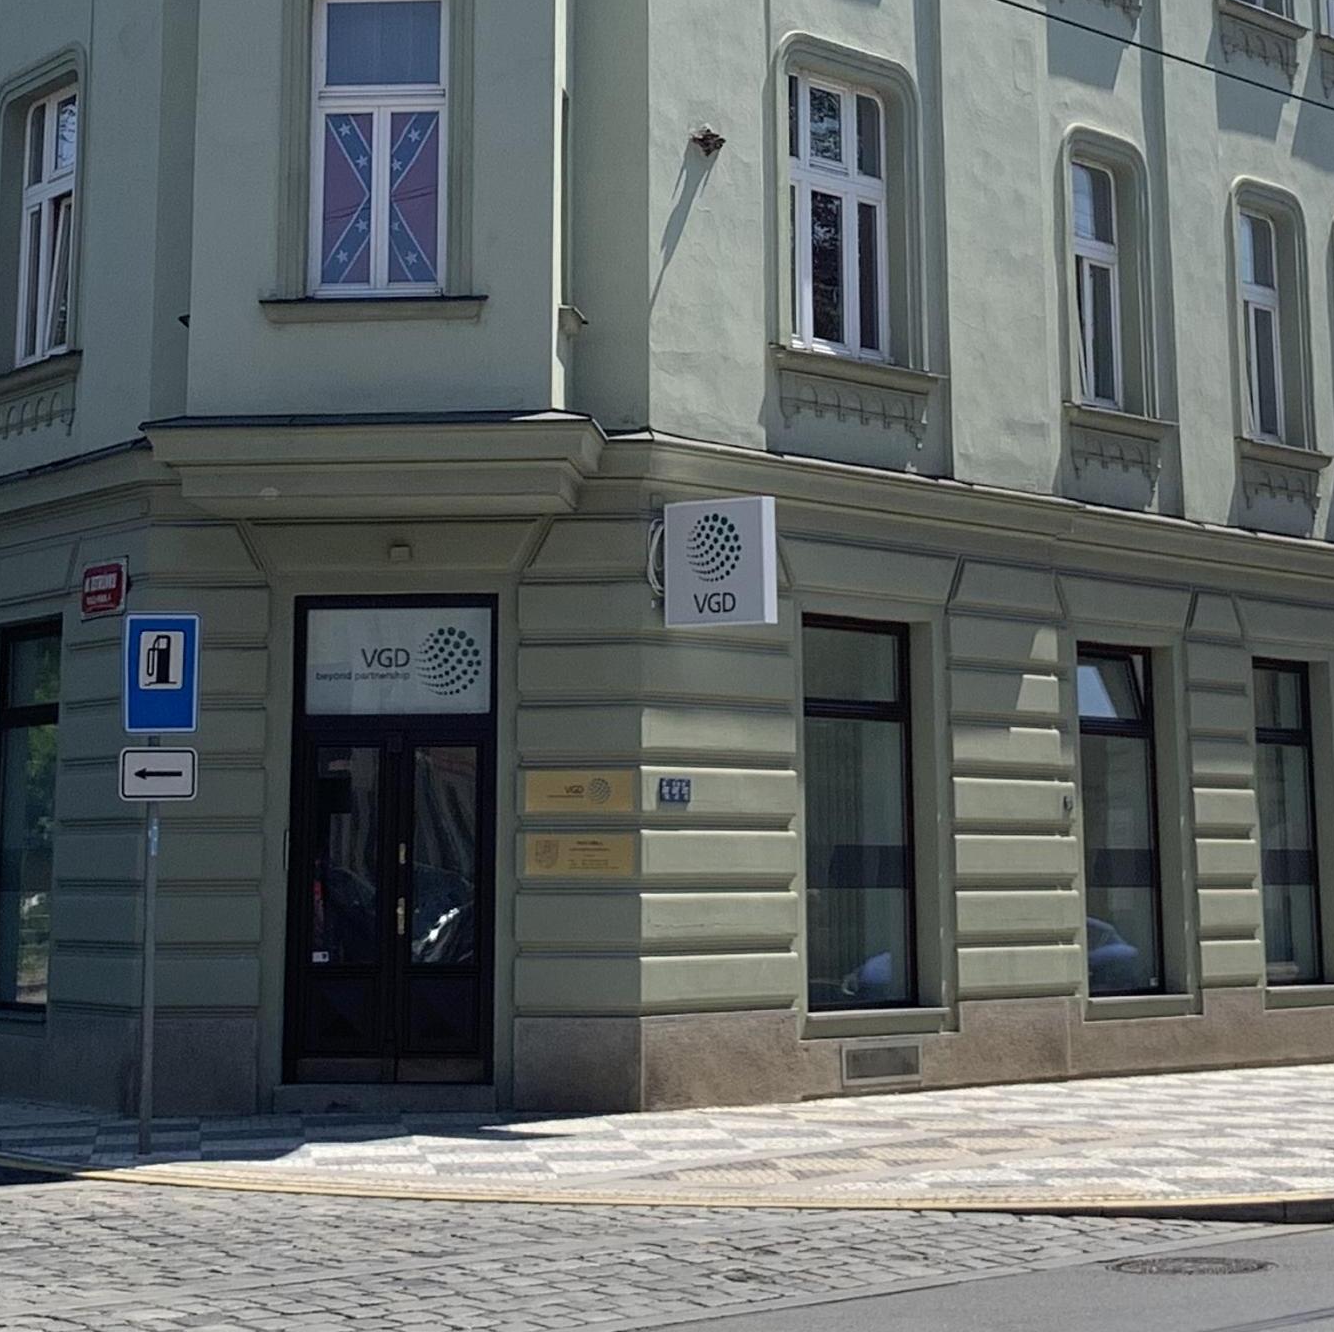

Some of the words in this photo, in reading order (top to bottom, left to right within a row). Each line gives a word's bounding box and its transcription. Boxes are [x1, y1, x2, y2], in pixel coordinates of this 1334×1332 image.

[693, 592, 736, 613] VGD
[361, 648, 410, 668] VGD
[316, 672, 352, 682] beyond
[355, 672, 411, 682] partnership
[564, 785, 585, 794] VGD
